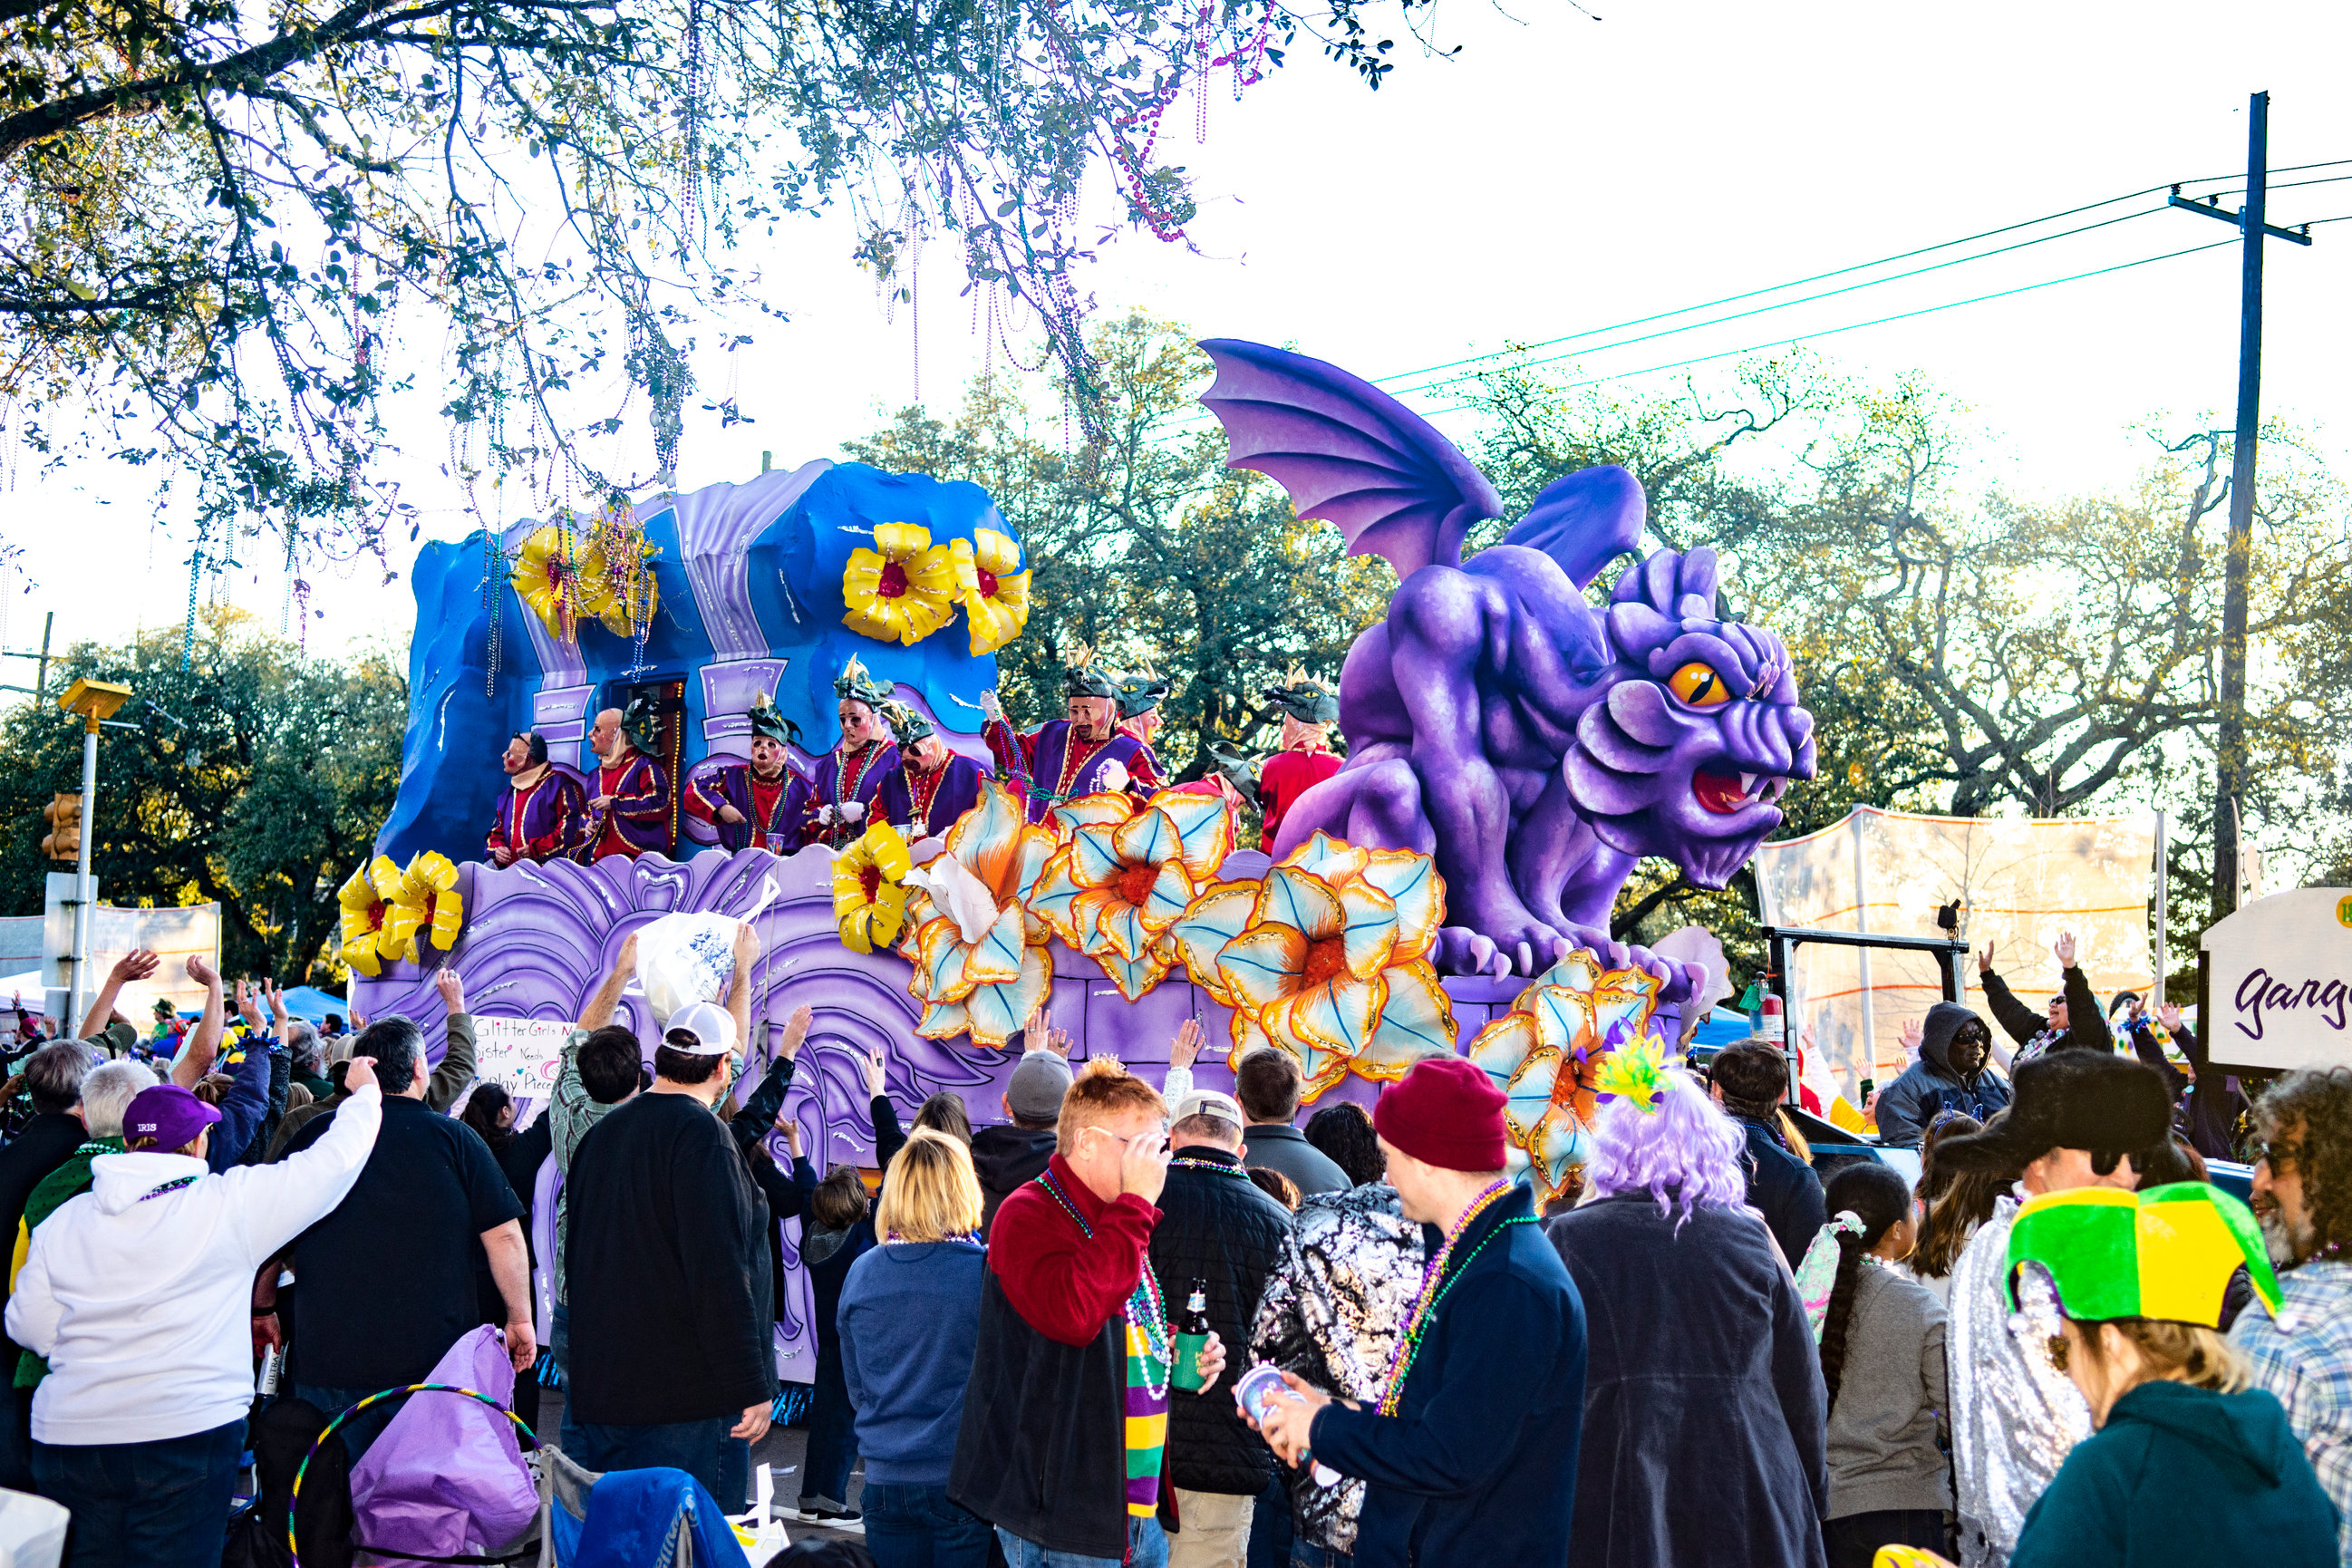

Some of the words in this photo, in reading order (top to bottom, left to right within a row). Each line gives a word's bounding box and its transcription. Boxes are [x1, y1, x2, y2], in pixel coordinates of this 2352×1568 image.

[472, 1019, 526, 1037] Glitter
[529, 1021, 556, 1037] Girls
[520, 1047, 544, 1060] Needs
[526, 1073, 551, 1089] Piece
[138, 1123, 158, 1132] IRIS
[267, 1356, 279, 1385] ULTRA
